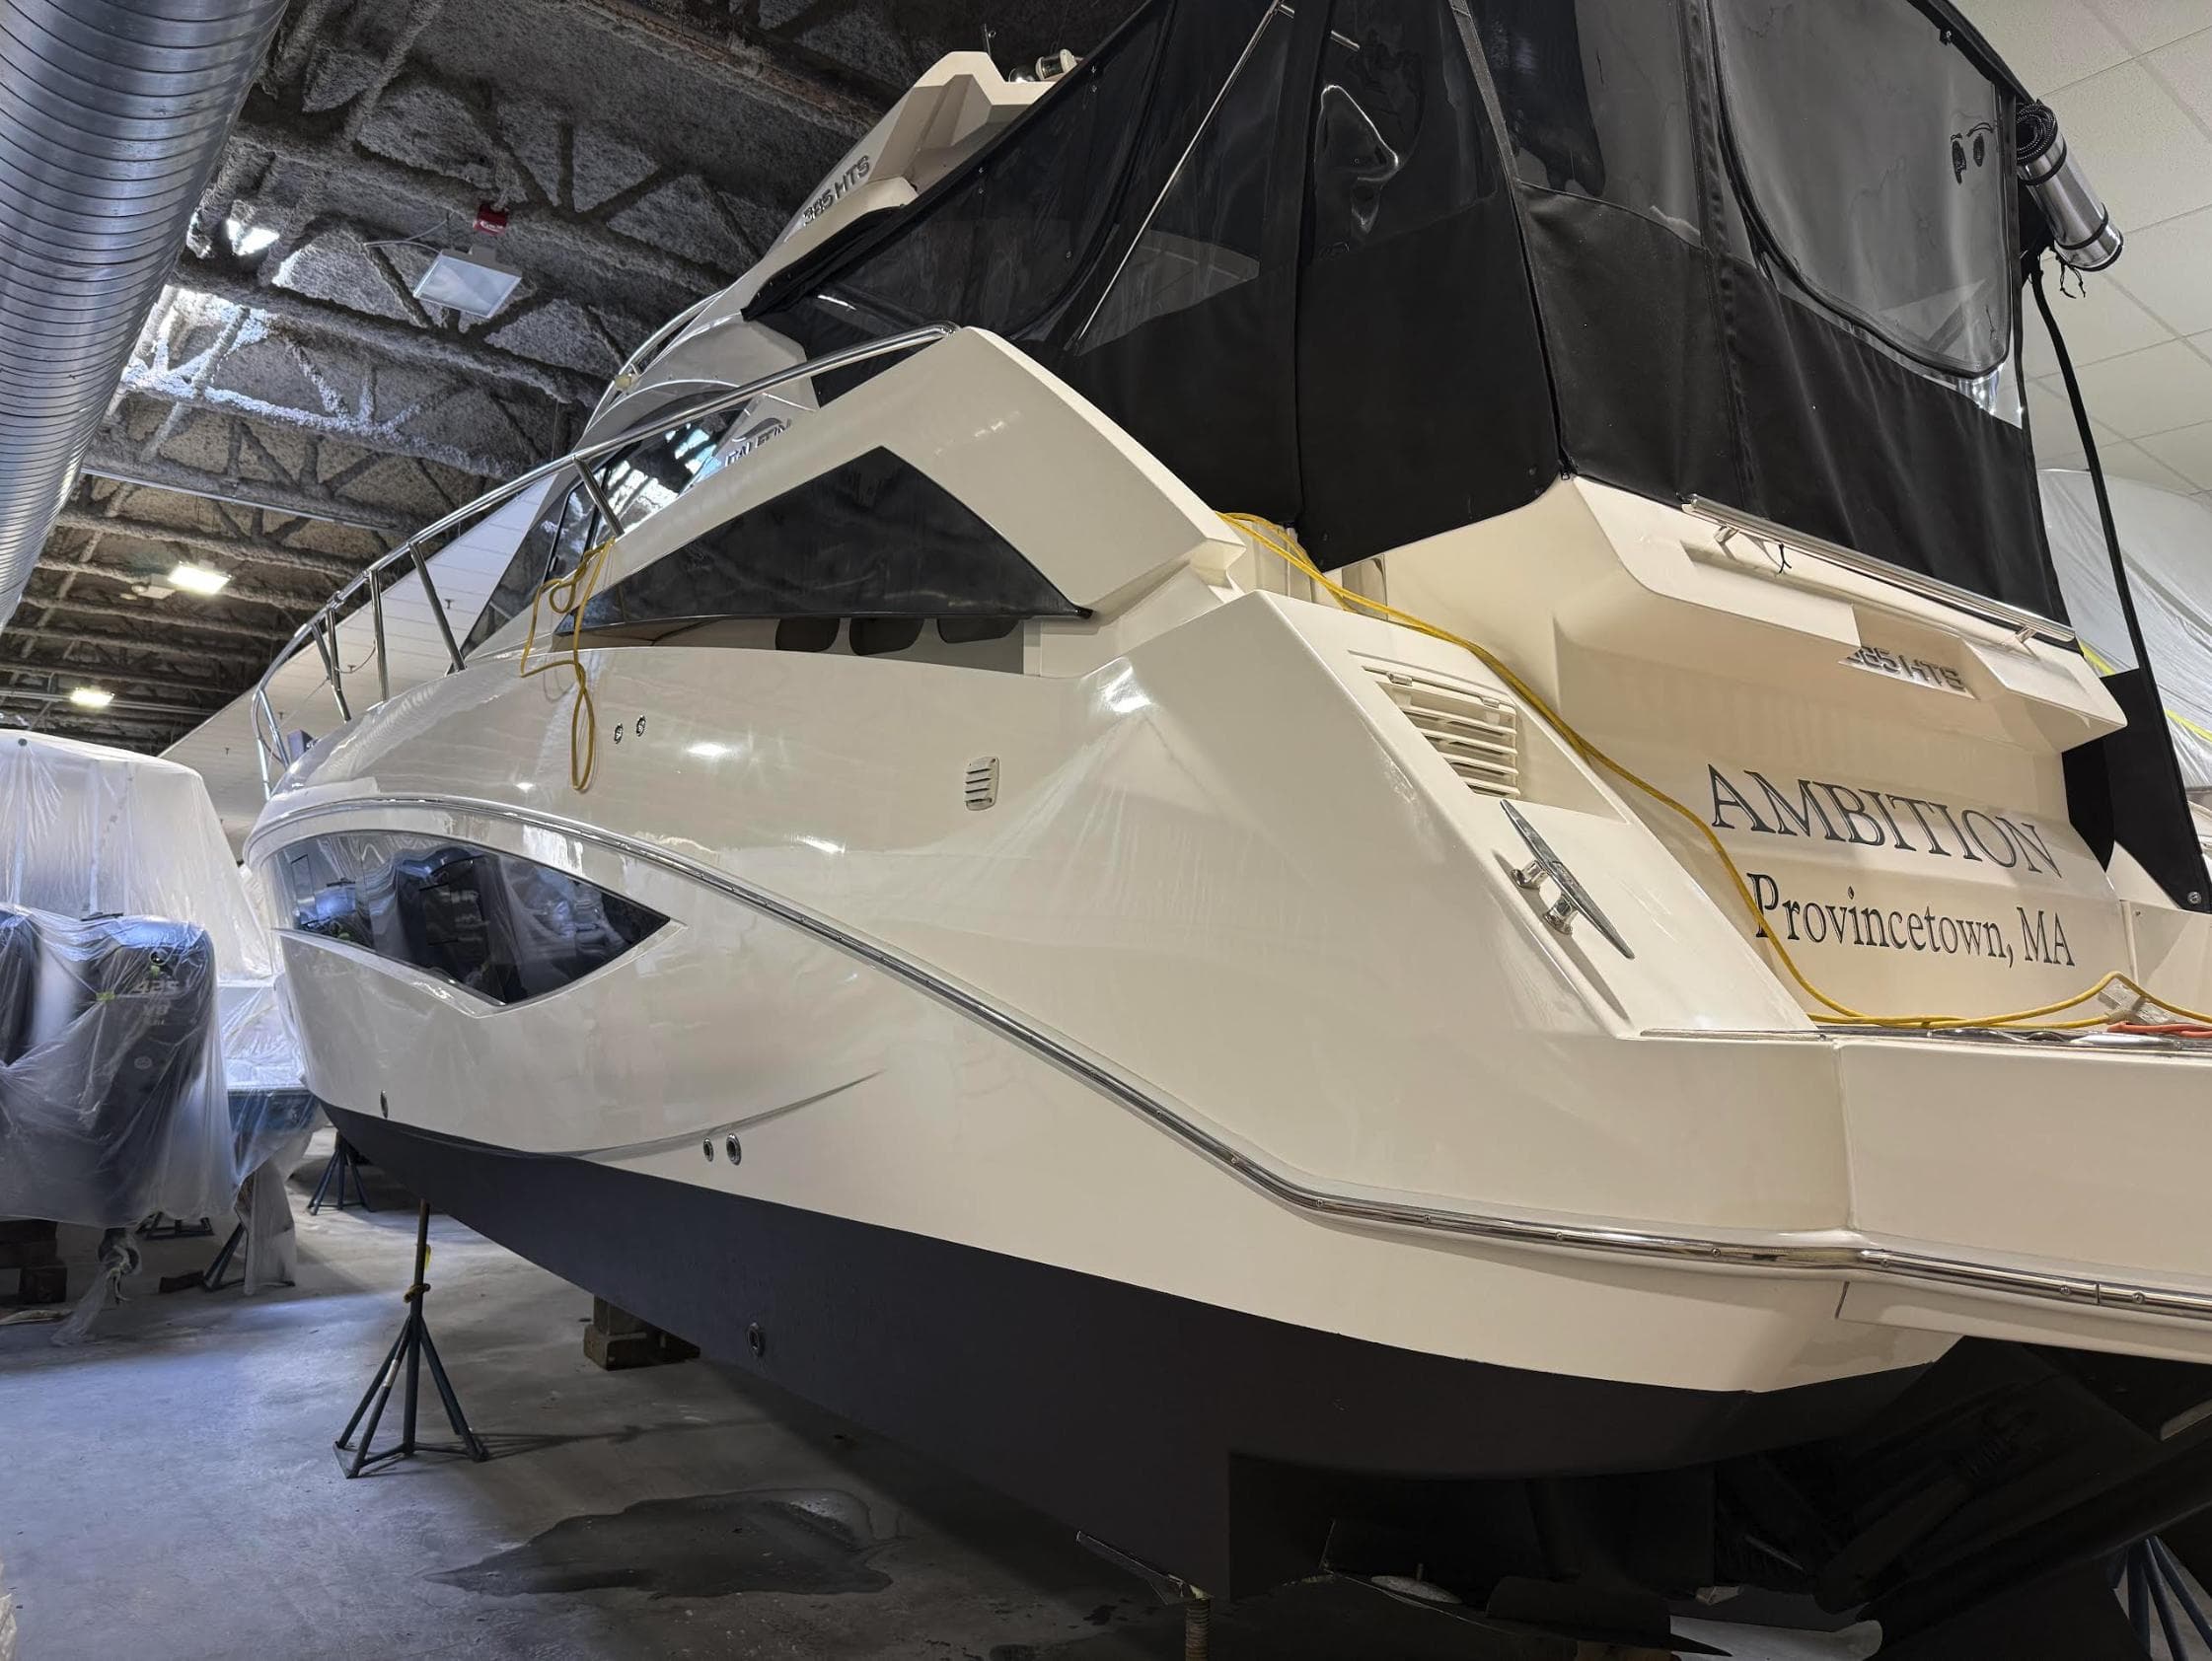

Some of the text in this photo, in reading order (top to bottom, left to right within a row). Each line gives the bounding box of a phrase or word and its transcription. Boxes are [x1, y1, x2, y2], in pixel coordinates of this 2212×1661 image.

[834, 155, 869, 199] HTS
[1898, 655, 1967, 692] HTS
[1707, 764, 2063, 879] AMBITION
[1747, 872, 2076, 969] Provincetown, MA
